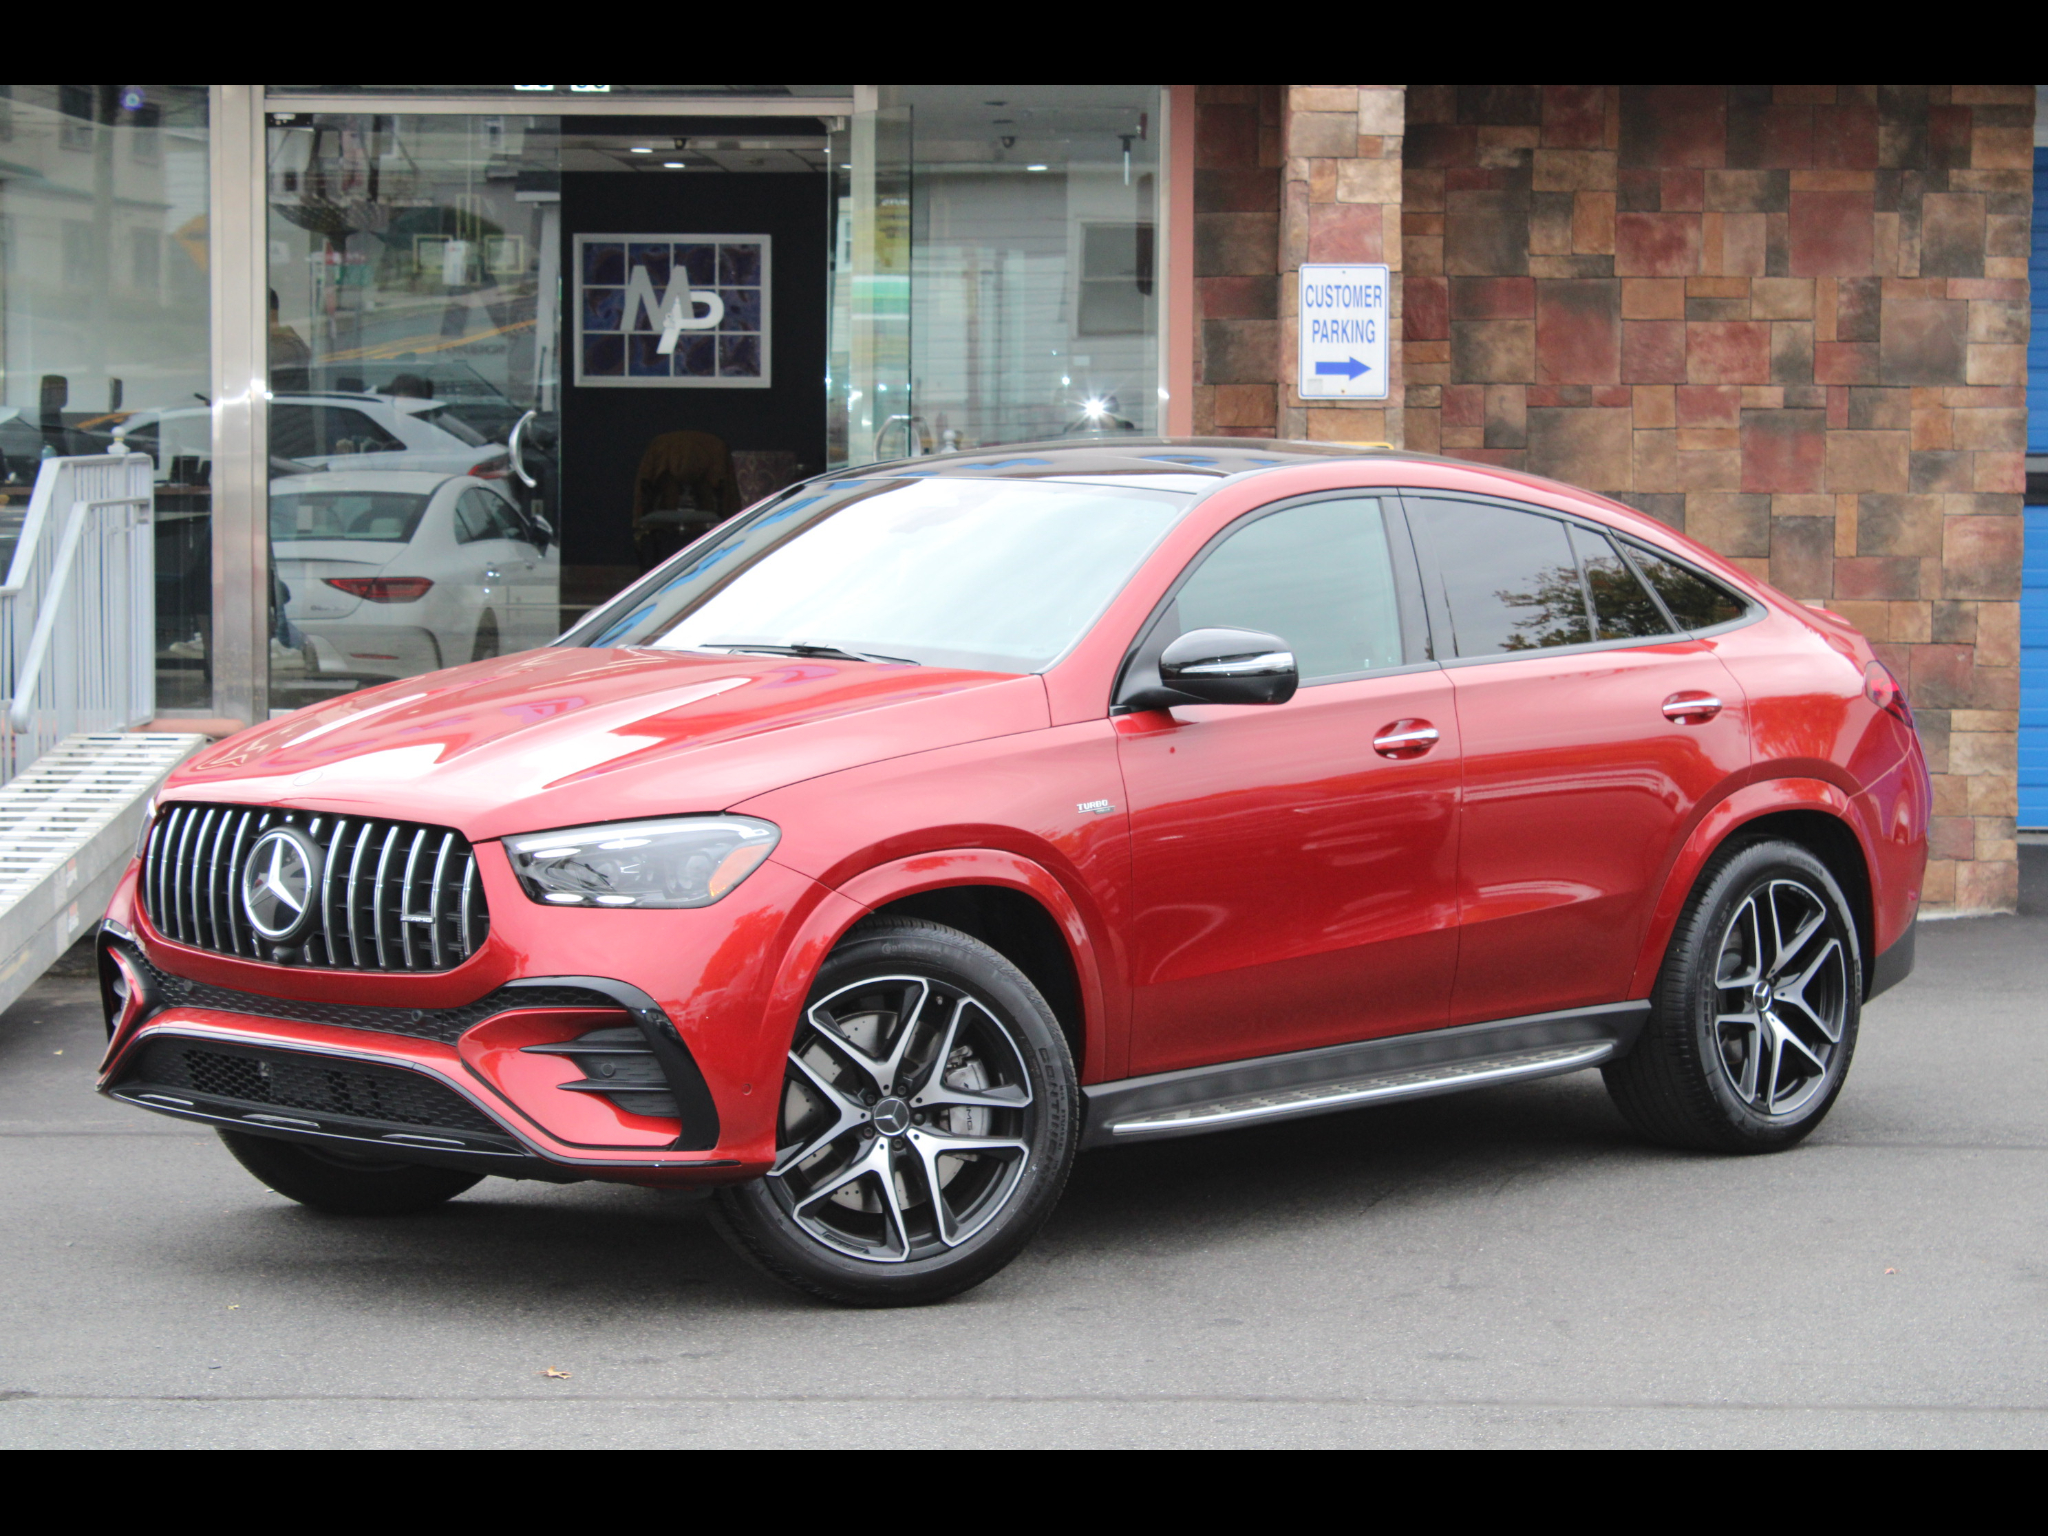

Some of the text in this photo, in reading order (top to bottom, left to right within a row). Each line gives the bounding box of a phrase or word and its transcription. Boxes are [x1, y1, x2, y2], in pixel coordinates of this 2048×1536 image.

[1305, 284, 1382, 308] CUSTOMER
[1312, 319, 1375, 344] PARKING
[1076, 799, 1108, 811] TURBO
